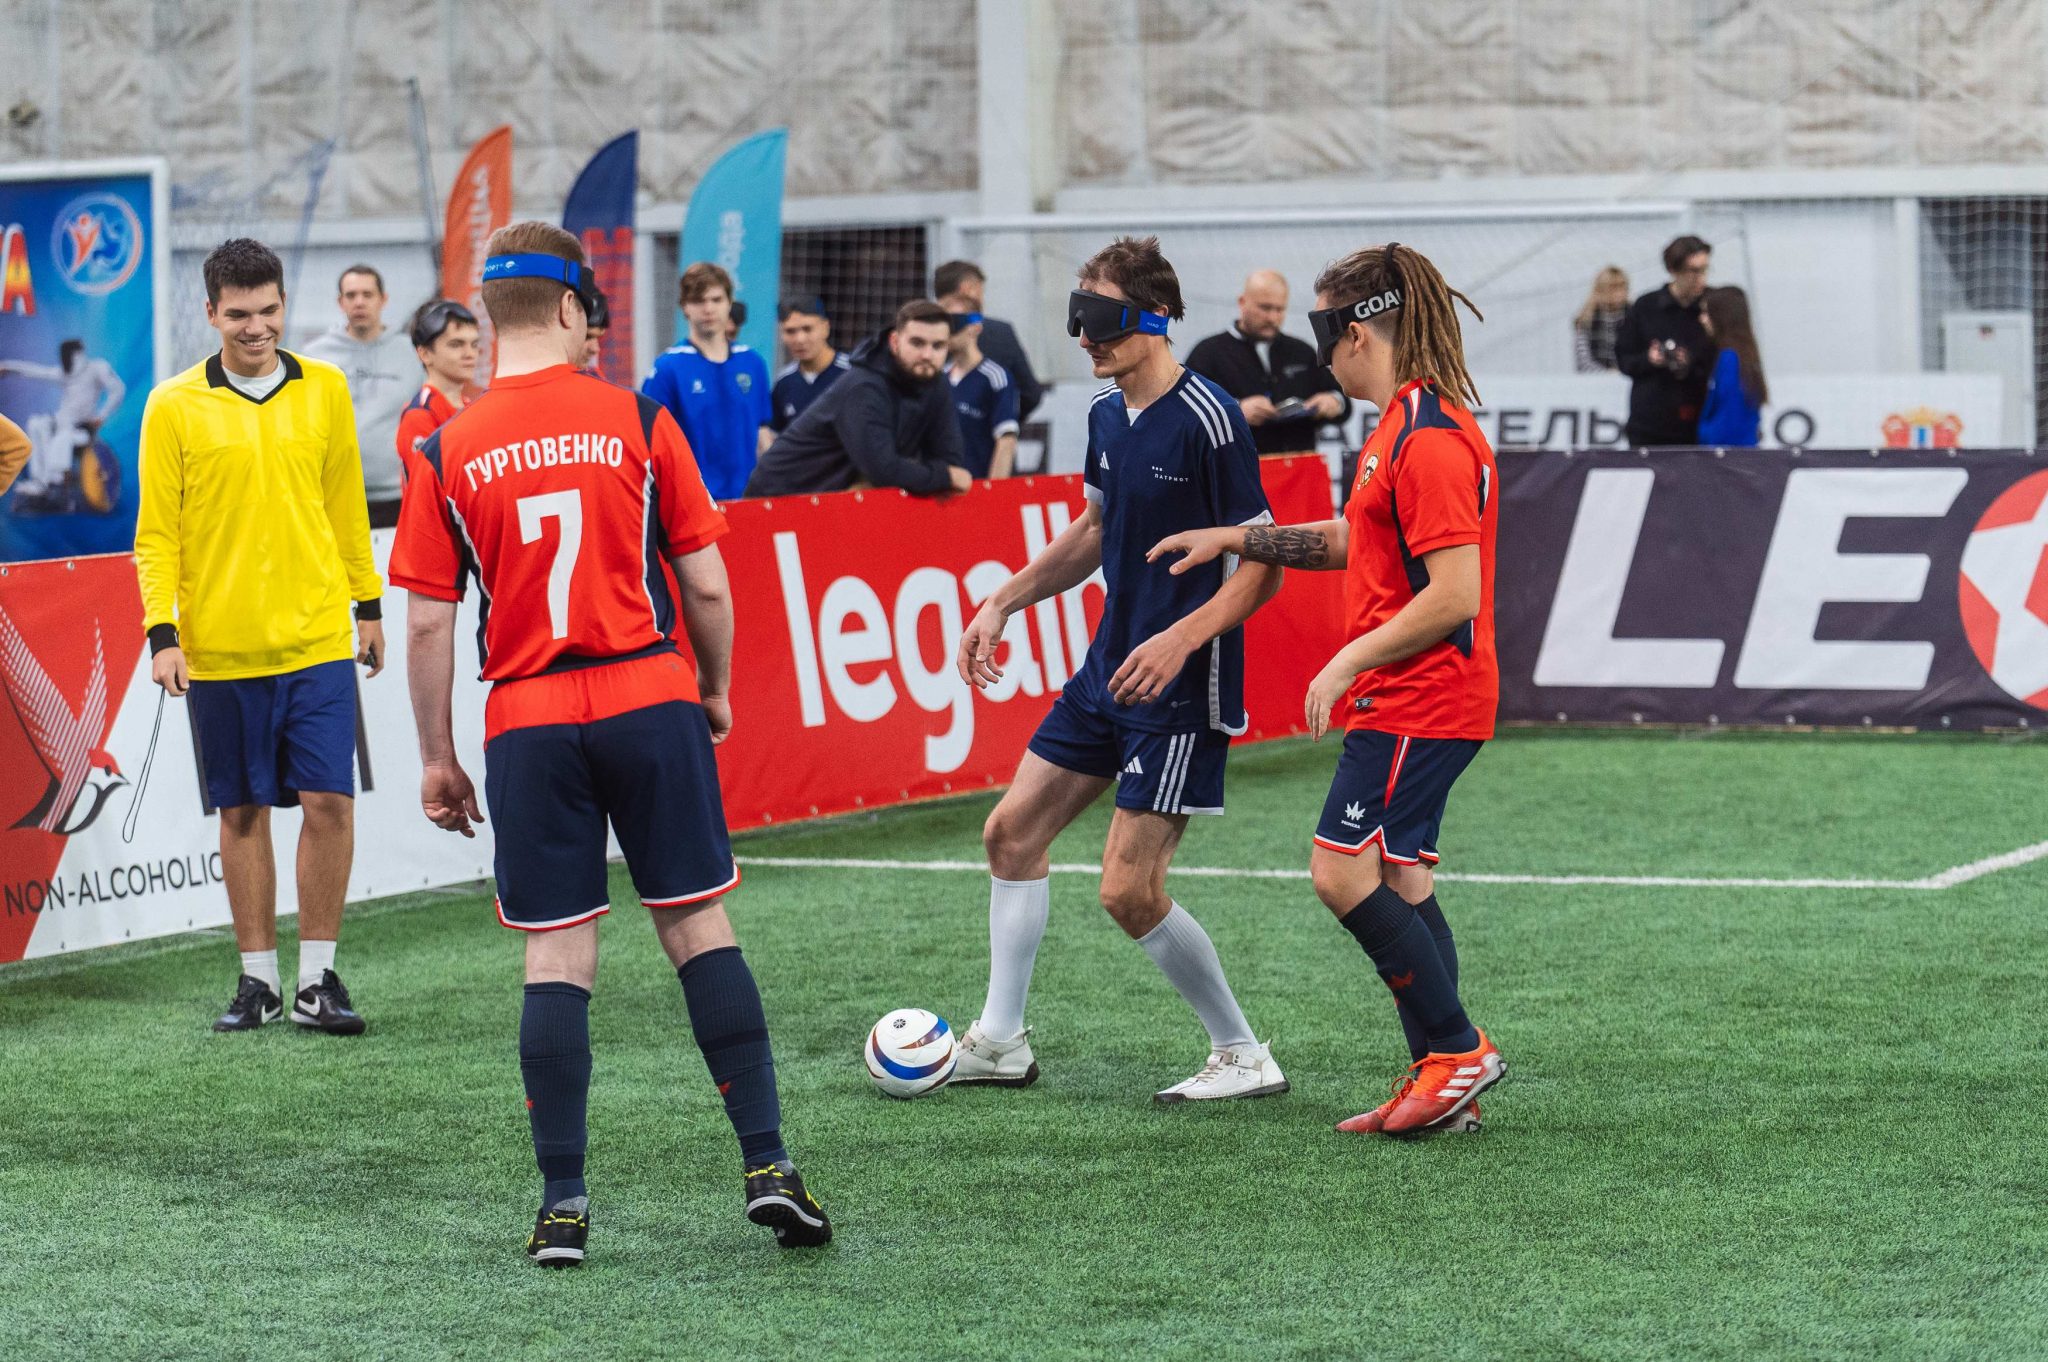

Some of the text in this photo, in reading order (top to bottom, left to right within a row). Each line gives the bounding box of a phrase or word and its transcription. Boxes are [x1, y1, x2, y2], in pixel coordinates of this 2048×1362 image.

[463, 433, 623, 492] ГУРТОВЕНКО
[1154, 473, 1189, 483] ПАТРИОТ
[516, 488, 583, 640] 7
